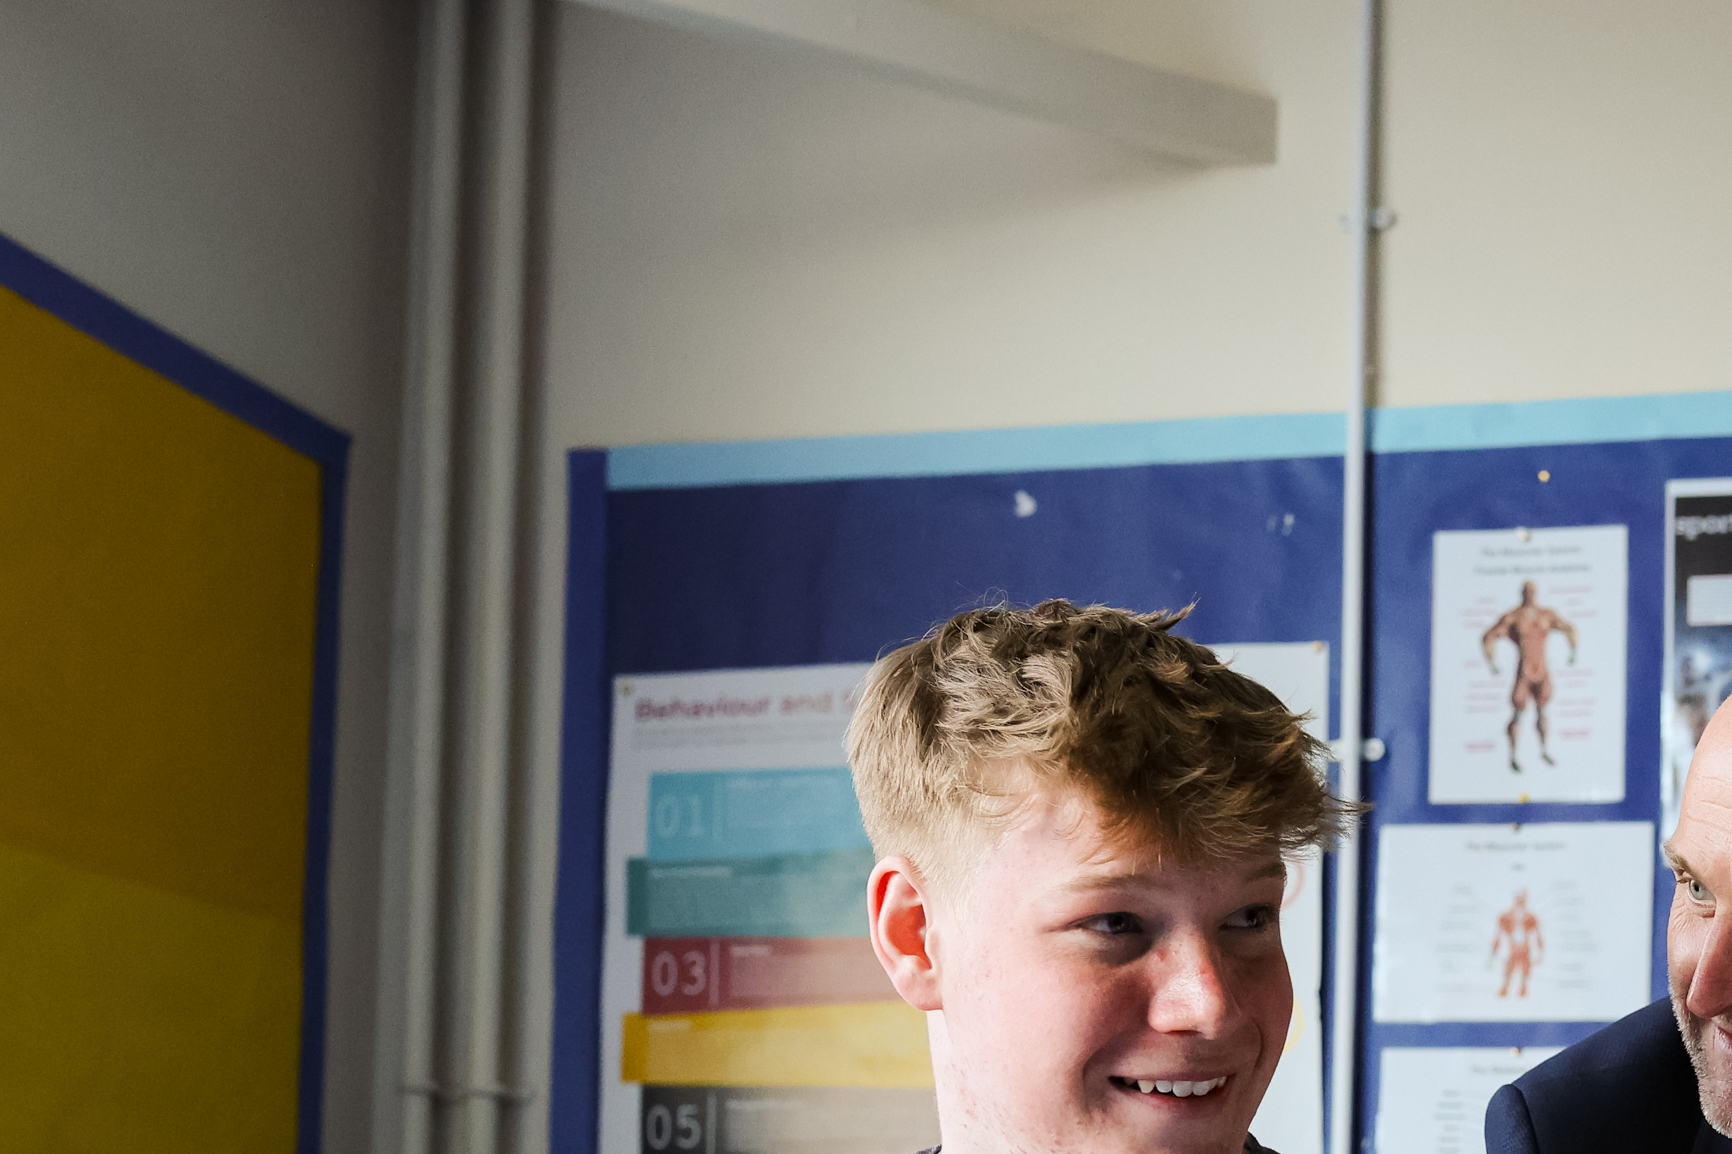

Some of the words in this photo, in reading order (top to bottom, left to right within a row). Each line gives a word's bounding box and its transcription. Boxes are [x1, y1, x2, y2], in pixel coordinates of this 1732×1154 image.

[635, 696, 771, 722] Behaviour
[779, 692, 834, 714] and
[656, 794, 706, 838] 01
[651, 950, 708, 997] 03
[645, 1103, 701, 1151] 05
